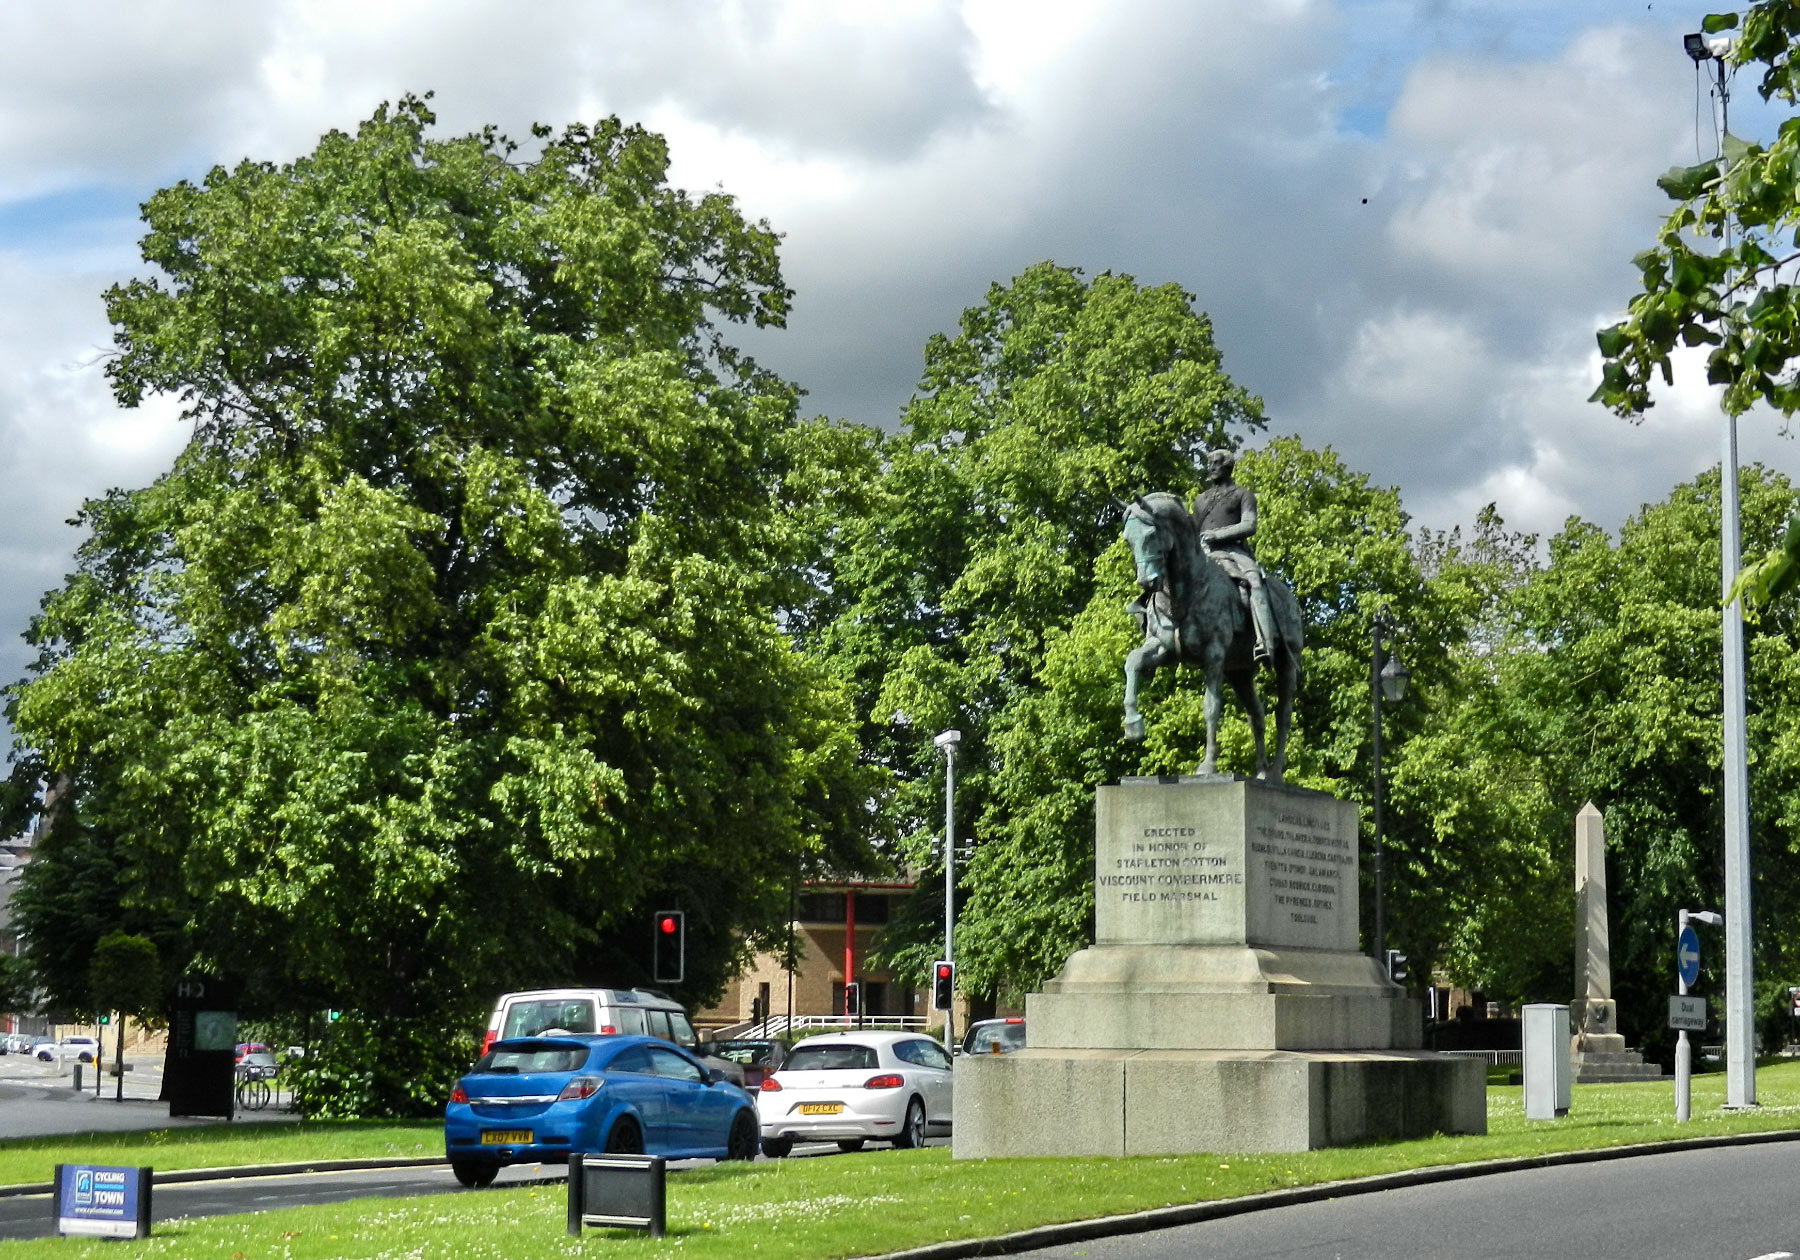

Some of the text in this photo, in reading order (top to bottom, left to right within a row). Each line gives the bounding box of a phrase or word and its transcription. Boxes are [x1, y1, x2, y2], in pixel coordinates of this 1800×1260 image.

[1144, 827, 1196, 838] ERECTED
[1132, 843, 1145, 852] IN
[1193, 842, 1208, 851] OF
[1116, 856, 1227, 868] STAPLETON COTTON
[1099, 873, 1242, 886] VISCOUNT COMBERMERE
[1122, 891, 1218, 902] FIELD MARSHAL
[94, 1172, 125, 1184] CYCLING
[94, 1191, 125, 1205] TOWN
